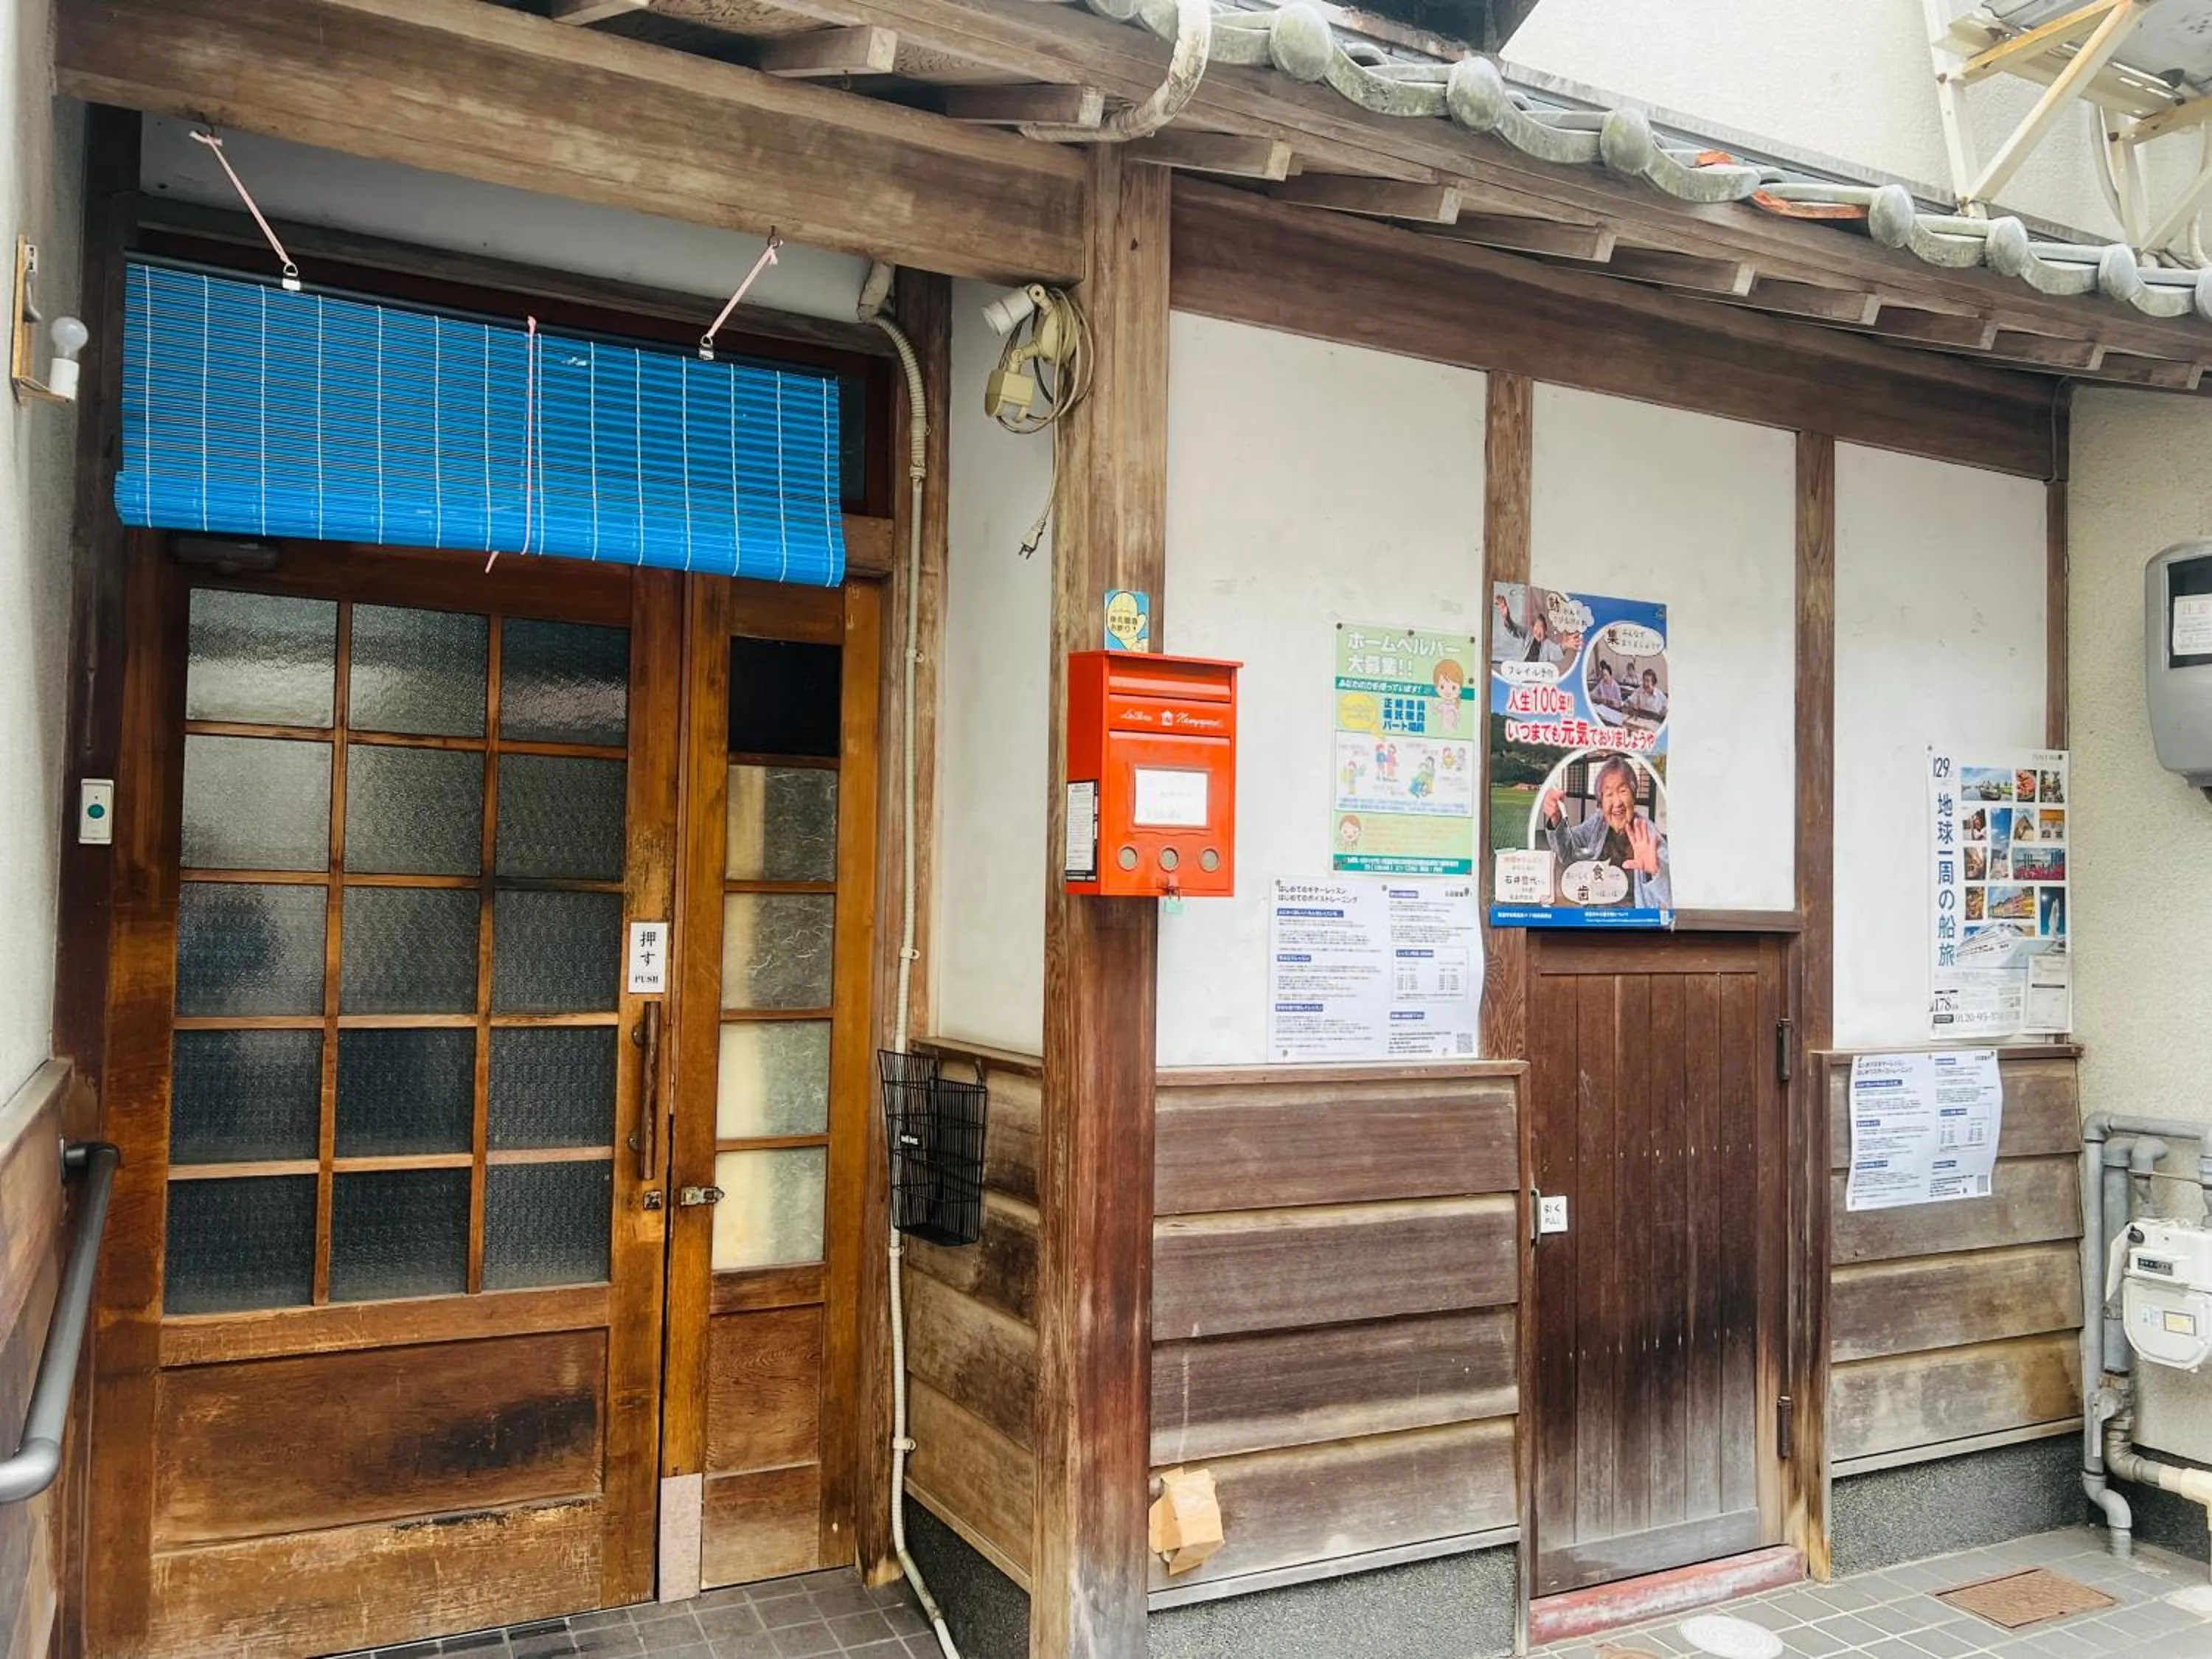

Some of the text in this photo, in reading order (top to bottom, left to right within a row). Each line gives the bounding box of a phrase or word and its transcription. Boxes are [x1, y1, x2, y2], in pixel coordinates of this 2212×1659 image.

[1937, 793, 1956, 967] 地球一周の船旅
[639, 931, 656, 966] 押す
